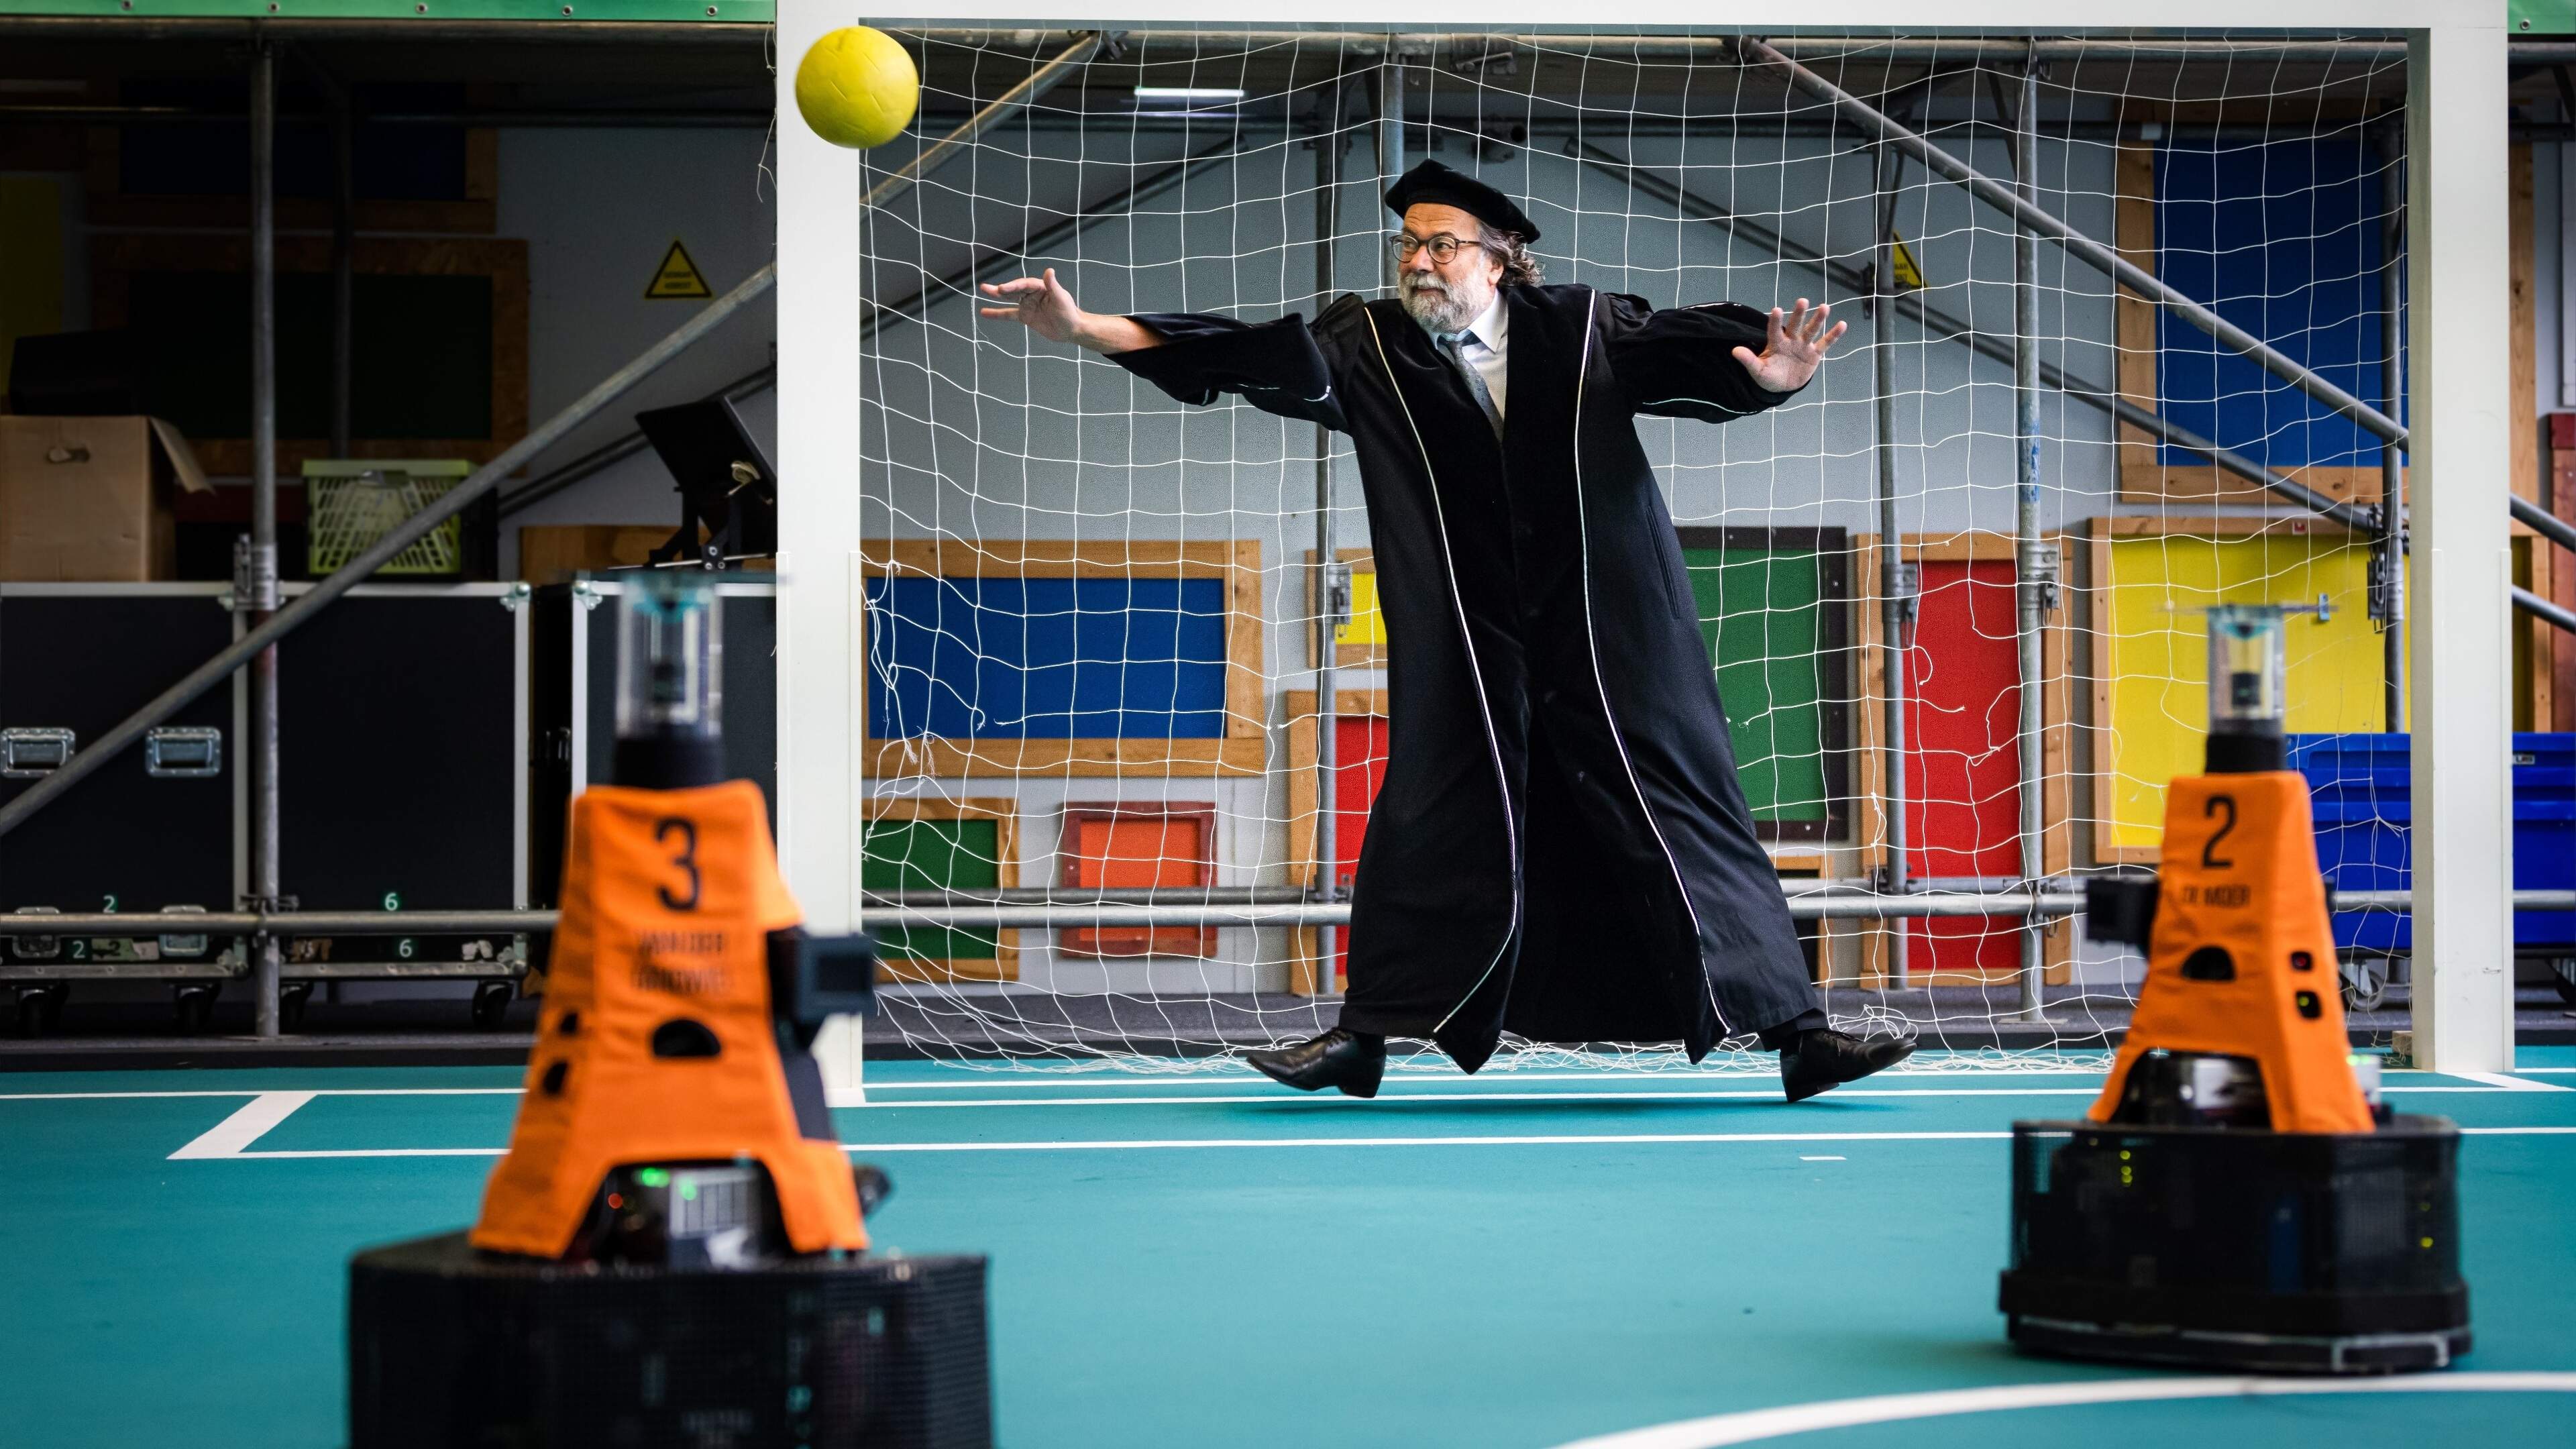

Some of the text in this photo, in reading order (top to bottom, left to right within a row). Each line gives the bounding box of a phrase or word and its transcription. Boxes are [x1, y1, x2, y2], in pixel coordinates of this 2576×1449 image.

[2203, 795, 2237, 869] 2
[655, 816, 699, 912] 3
[103, 895, 115, 913] 2
[385, 892, 398, 911] 6
[72, 941, 85, 959] 2
[400, 938, 413, 957] 6
